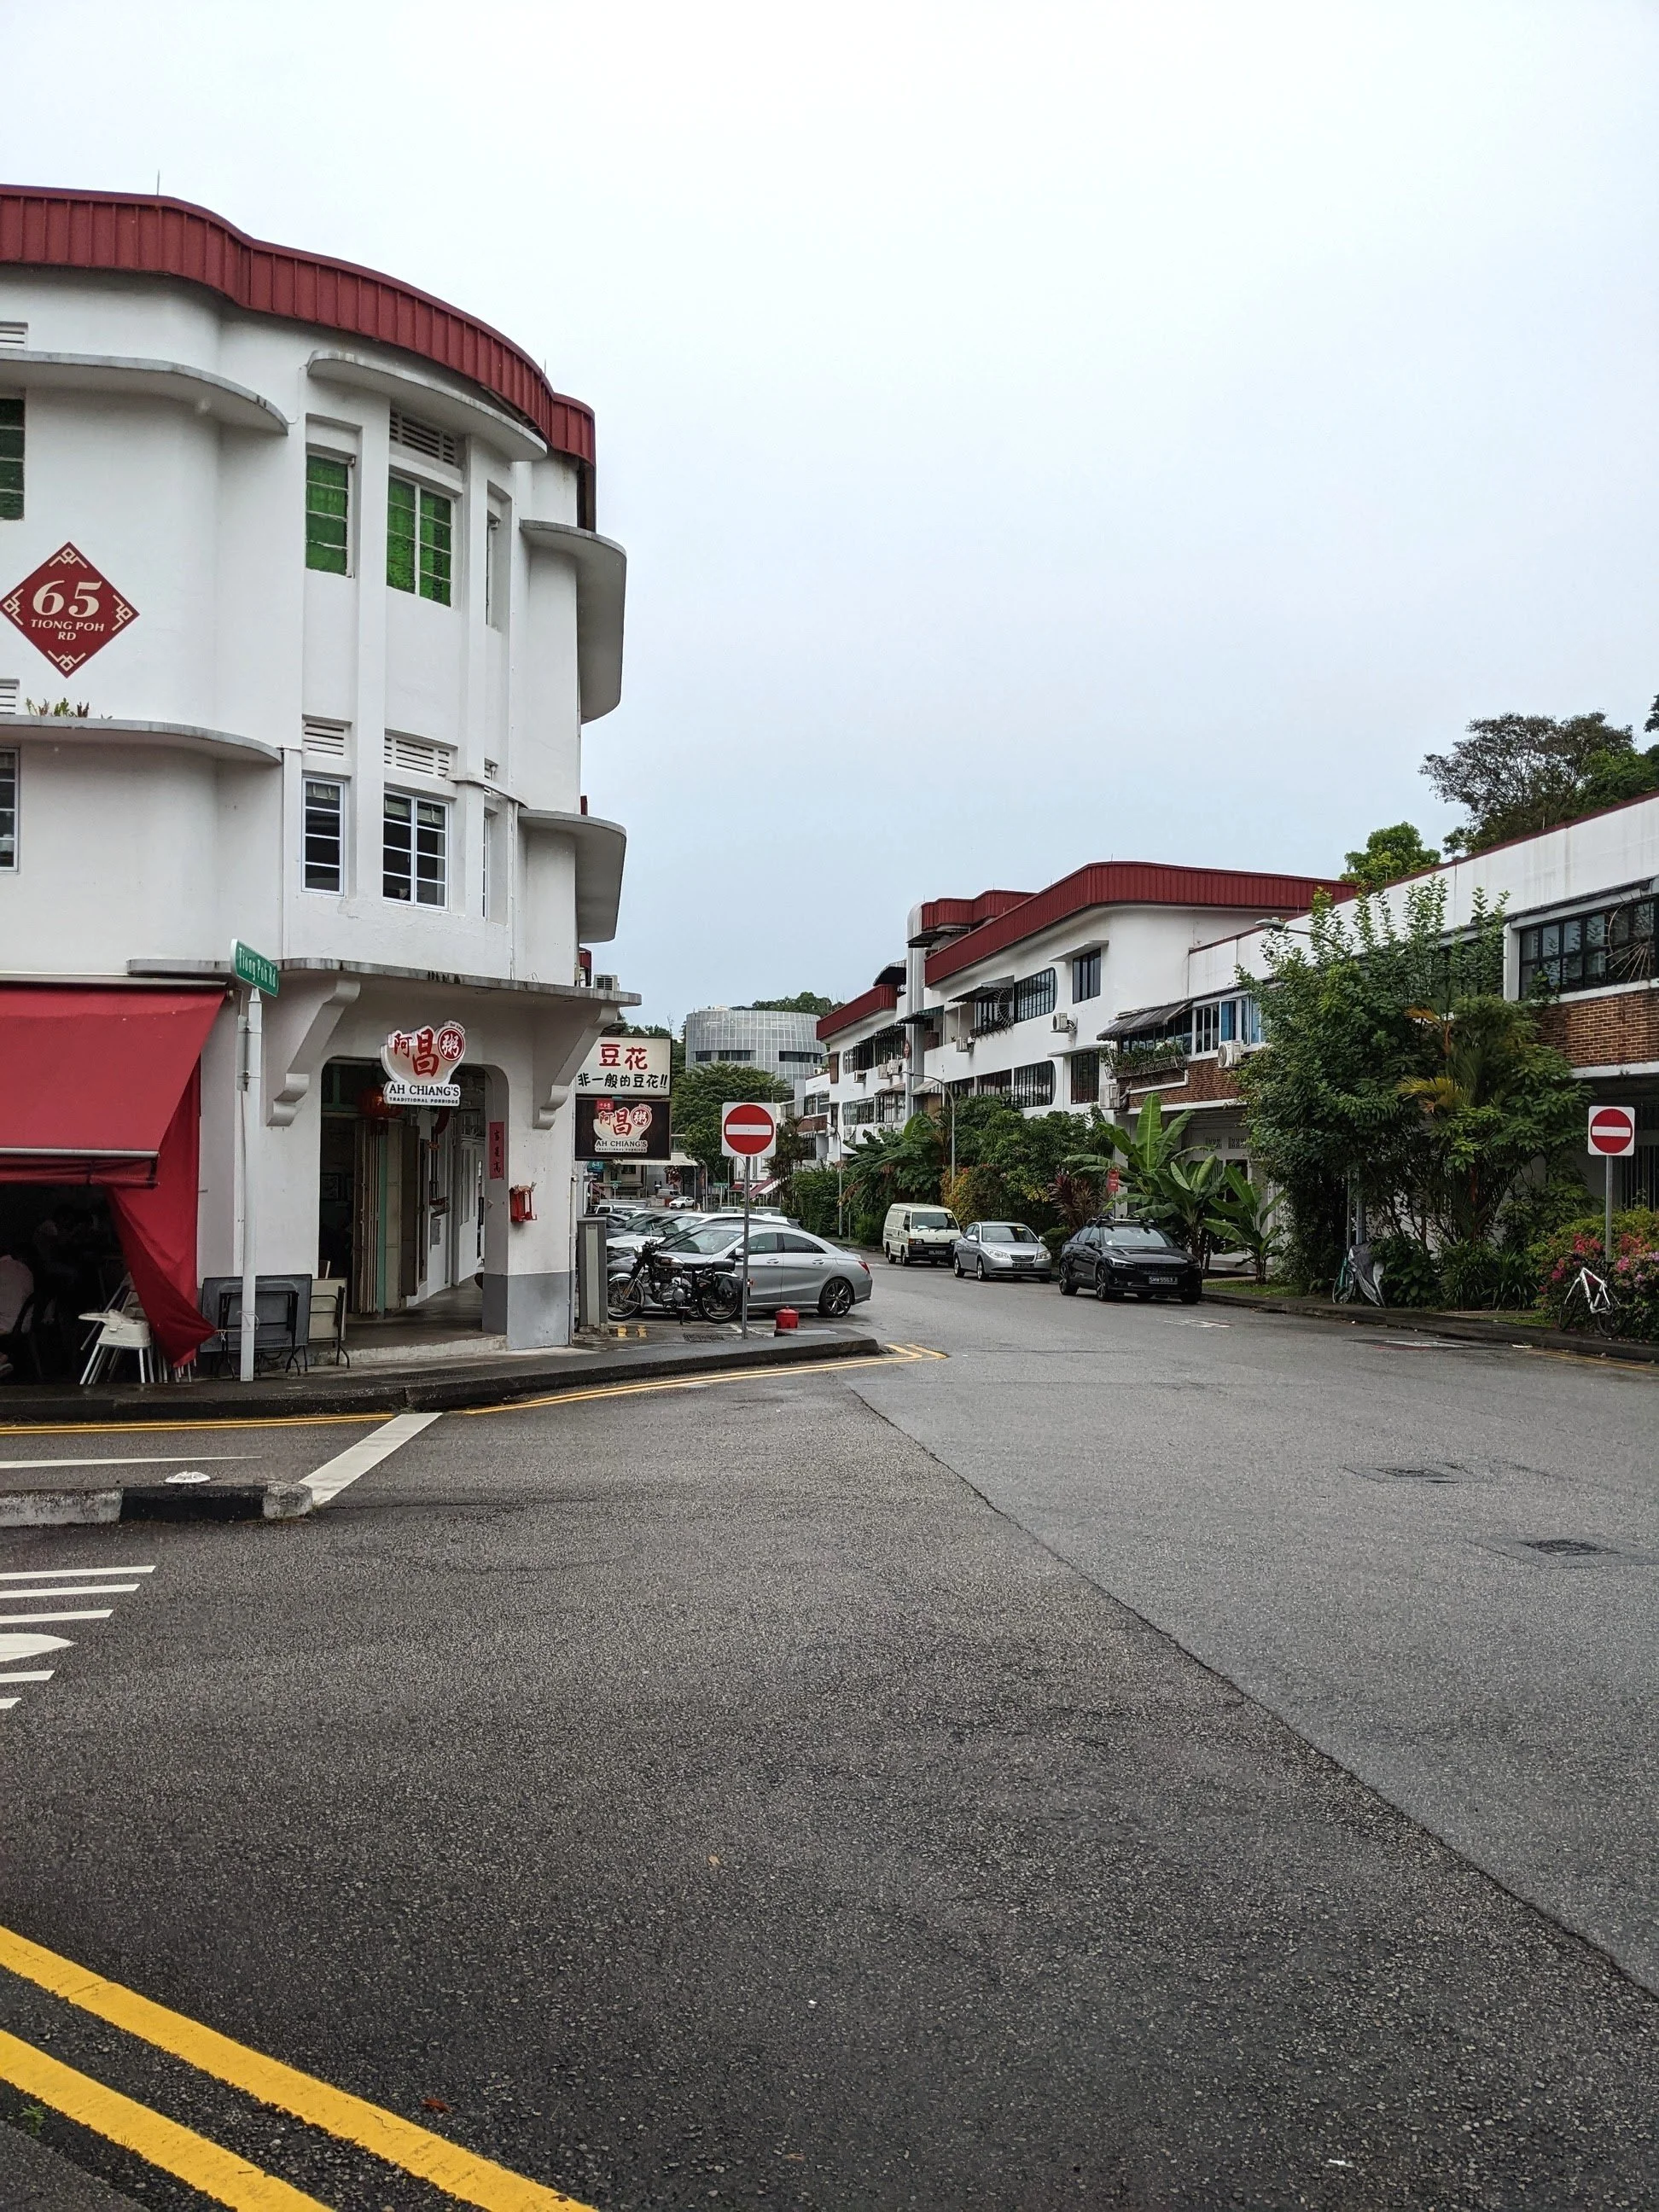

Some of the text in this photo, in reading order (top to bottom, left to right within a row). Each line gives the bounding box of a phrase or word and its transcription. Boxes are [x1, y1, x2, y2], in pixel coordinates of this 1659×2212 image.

[32, 580, 102, 618] 65
[31, 619, 104, 632] TIONG POH
[58, 632, 76, 641] RD
[239, 946, 276, 987] Tiong Poh Rd
[599, 1044, 648, 1070] 豆花
[389, 1084, 460, 1097] AH CHIANG'S
